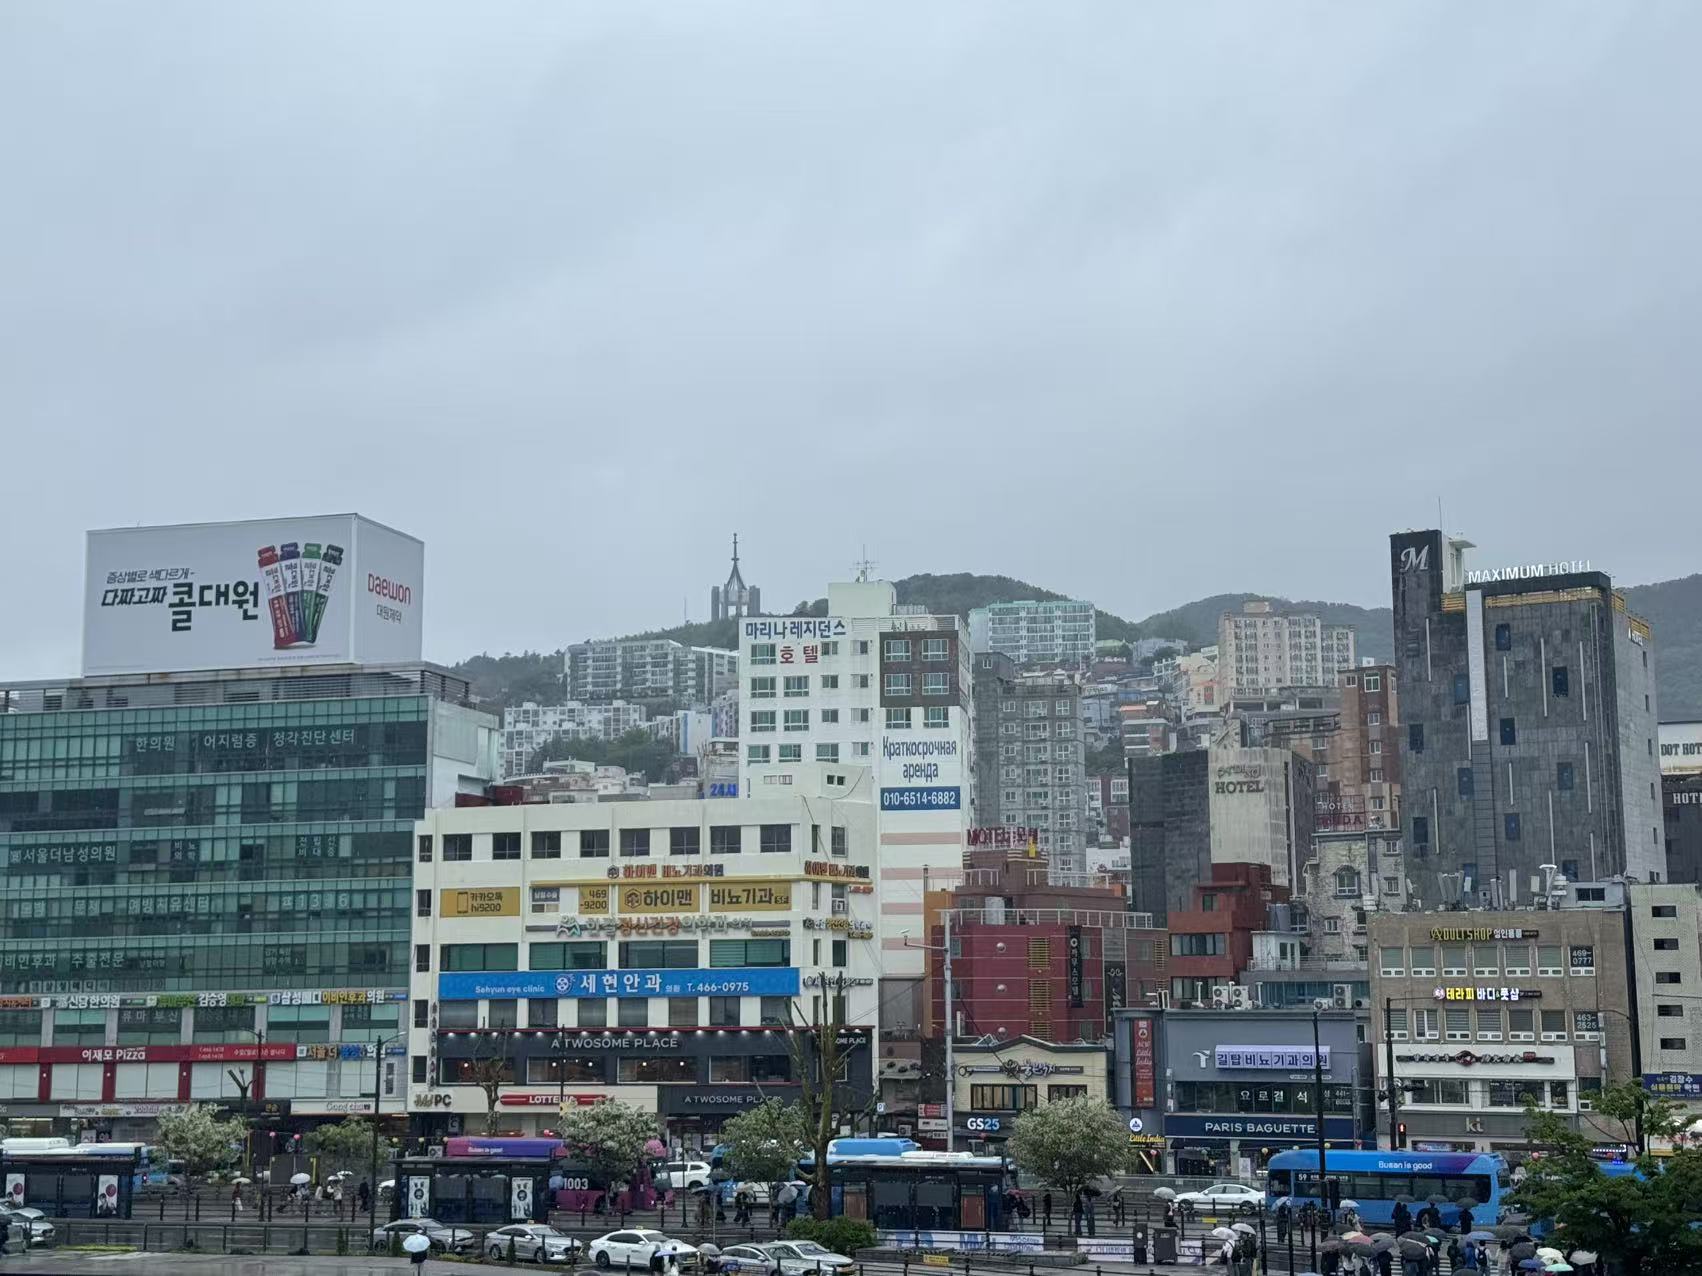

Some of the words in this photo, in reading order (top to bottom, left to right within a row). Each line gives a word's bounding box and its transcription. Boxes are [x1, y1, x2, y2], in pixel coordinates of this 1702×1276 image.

[1400, 544, 1430, 572] M
[106, 571, 148, 585] 증상별로
[1468, 564, 1543, 583] MAXIMUM
[1549, 560, 1592, 575] HOTEL
[101, 586, 168, 607] 다짜고짜
[168, 580, 259, 632] 콜대원
[136, 736, 175, 751] 한의원
[204, 733, 257, 748] 어지럼증
[882, 736, 957, 760] Краткосрочная
[1661, 743, 1680, 756] DOT
[903, 763, 939, 783] аренда
[1214, 781, 1264, 794] HOTEL
[884, 791, 956, 806] 010-6514-6882
[967, 828, 1010, 846] MOTEL
[623, 864, 657, 877] 하이맨
[470, 892, 503, 902] 카카오톡
[589, 889, 607, 898] 469
[643, 888, 692, 908] 하이맨
[711, 887, 774, 906] 비뇨기과
[471, 903, 502, 912] hi9200
[579, 901, 608, 911] -9200
[1572, 949, 1591, 957] 469-
[1573, 957, 1592, 966] 0777
[580, 972, 662, 994] 세현안과
[475, 985, 505, 995] Sehyun
[506, 986, 521, 996] eye
[522, 985, 545, 993] clinic
[1446, 987, 1476, 1000] 테라피
[68, 994, 121, 1008] 신당한의원
[199, 993, 227, 1007] 김승영
[1576, 1013, 1597, 1022] 463-
[1576, 1021, 1597, 1029] 2525
[551, 1038, 560, 1049] A
[563, 1037, 630, 1049] TWOSOME
[634, 1037, 678, 1048] PLACE
[82, 1048, 114, 1062] 이재모
[116, 1048, 146, 1061] Pizza
[684, 1095, 691, 1104] A
[693, 1095, 743, 1104] TWOSOME
[966, 1118, 1000, 1130] GS25
[1205, 1122, 1243, 1133] PARIS
[1247, 1123, 1315, 1134] BAGUETTE
[1465, 1117, 1485, 1133] kt
[1378, 1161, 1403, 1169] Busan
[1404, 1161, 1411, 1169] is
[1412, 1161, 1433, 1171] good
[563, 1177, 589, 1190] 1003
